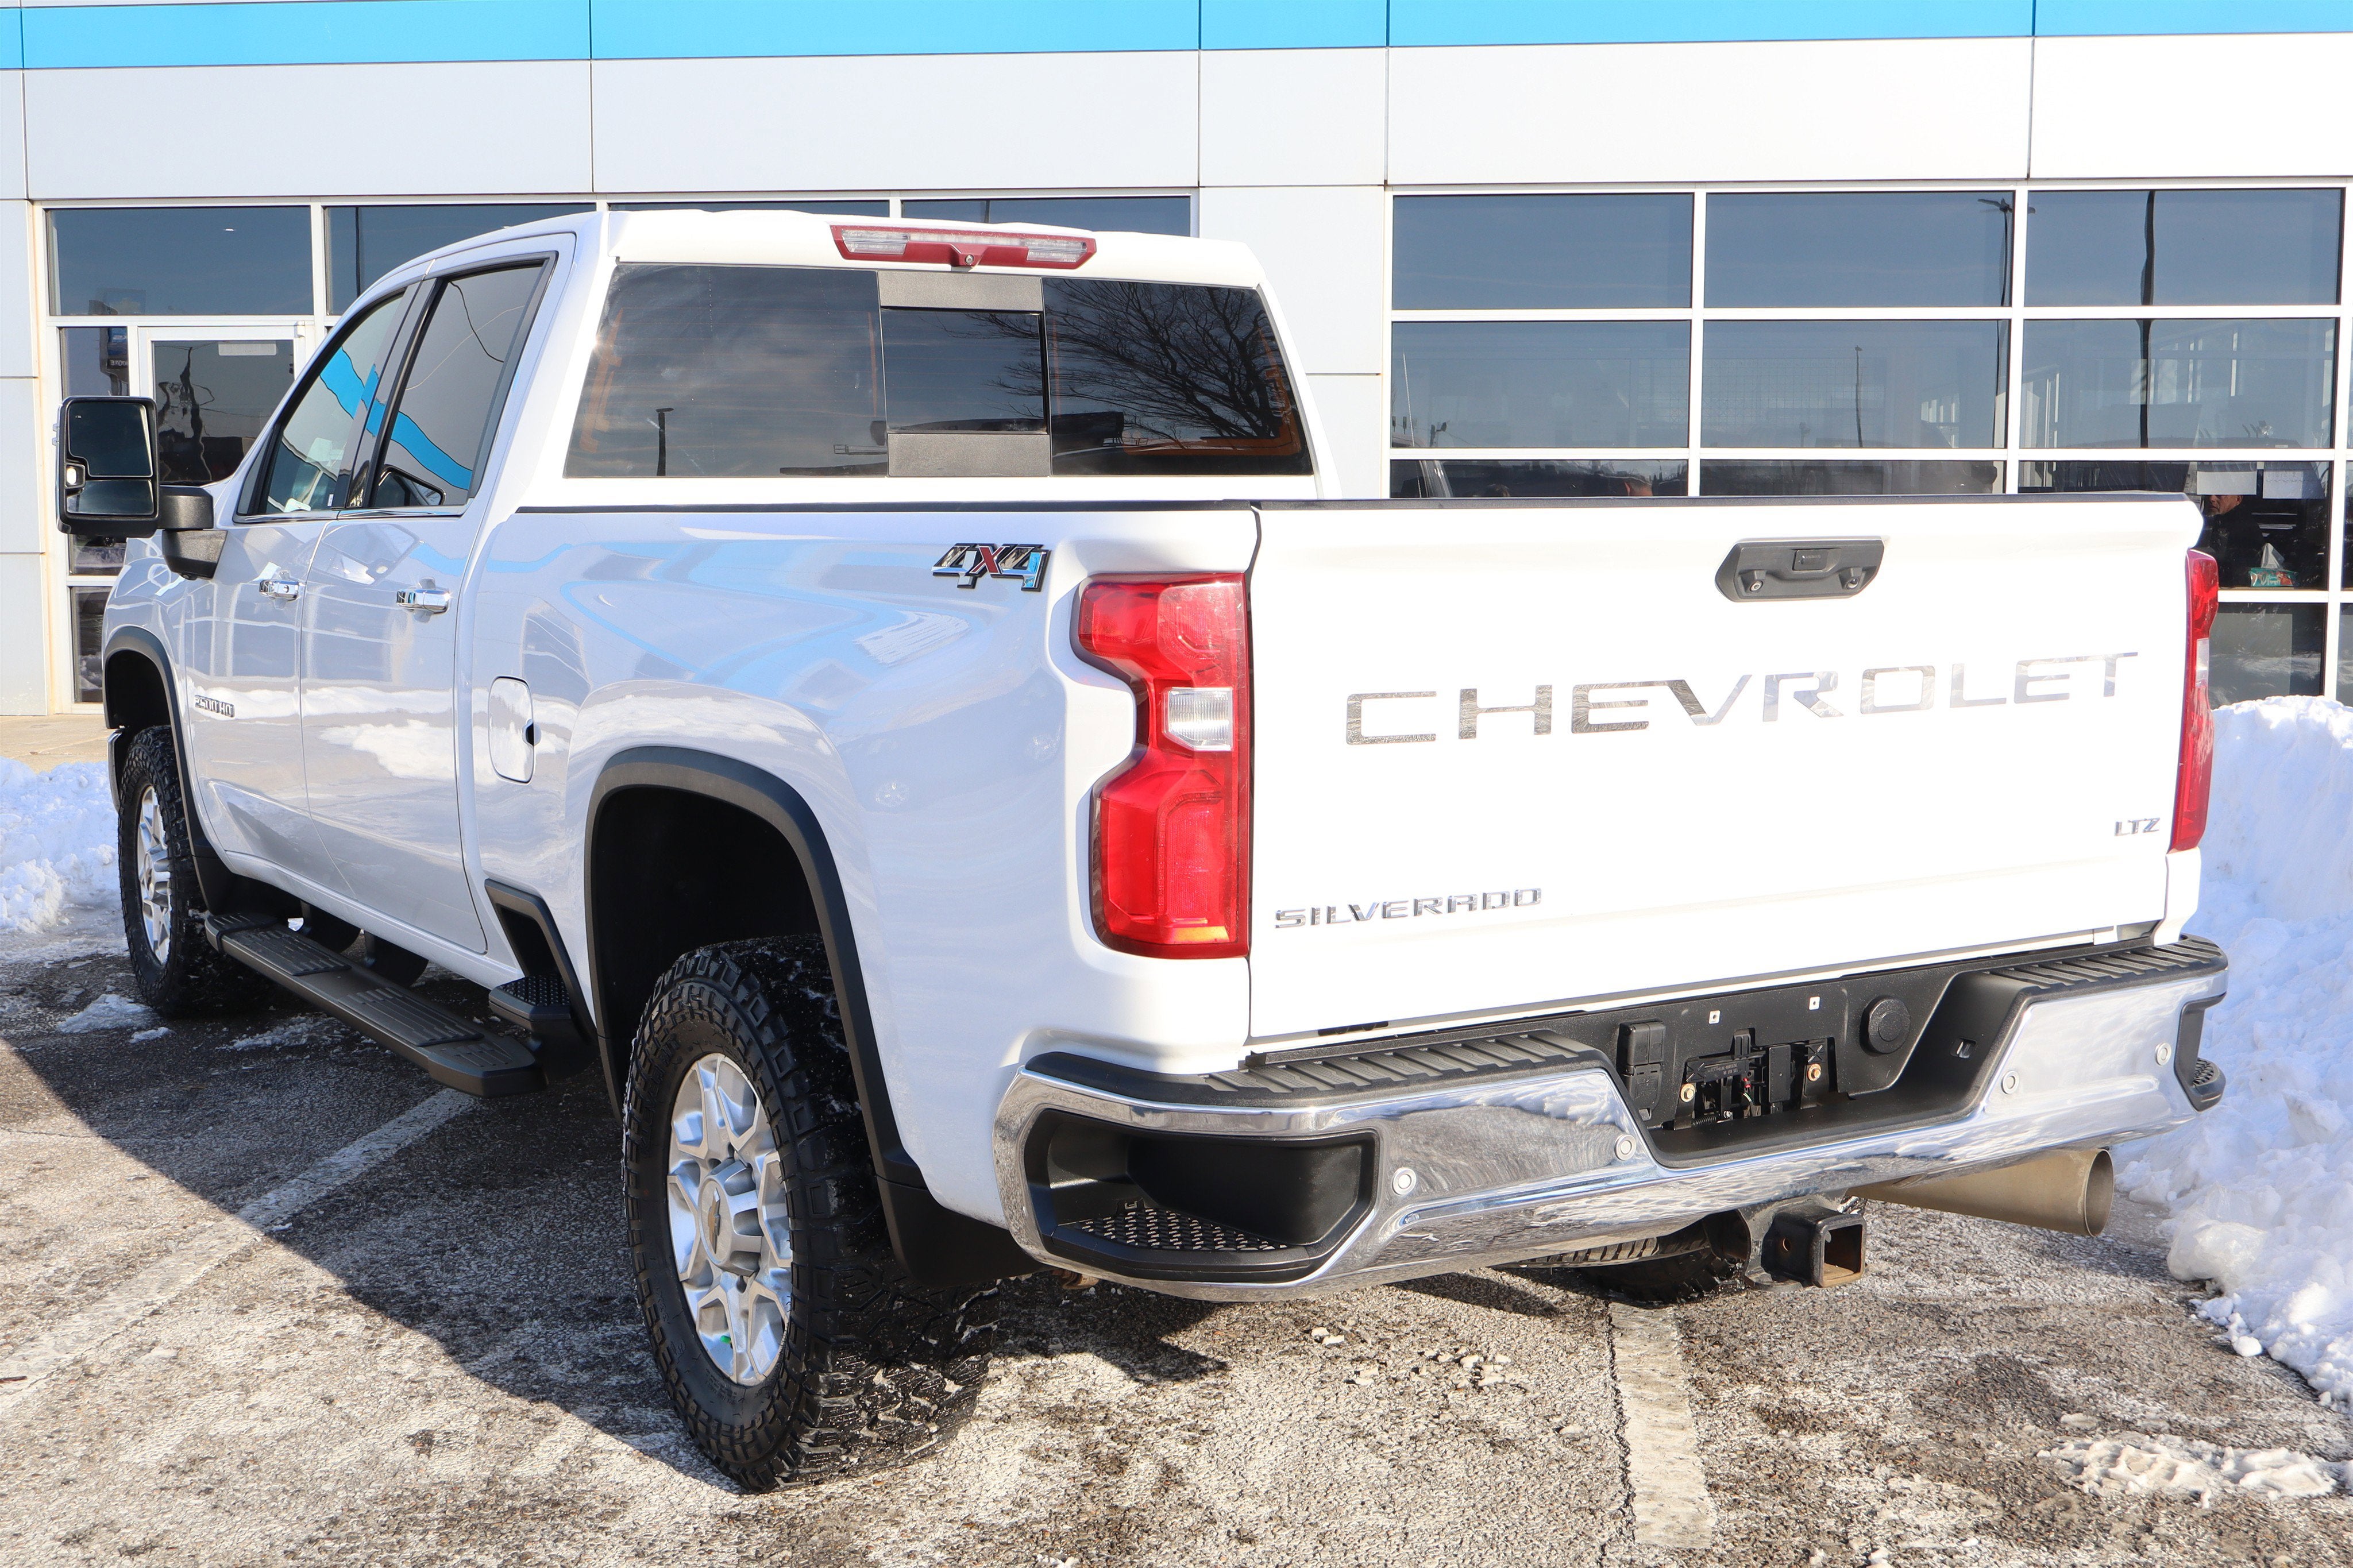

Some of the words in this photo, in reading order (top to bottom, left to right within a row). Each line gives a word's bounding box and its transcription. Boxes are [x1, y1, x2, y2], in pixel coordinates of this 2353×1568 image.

[1346, 652, 2138, 746] CHEVROLET
[2115, 817, 2161, 836] LTZ
[1275, 887, 1542, 929] SILVERADO
